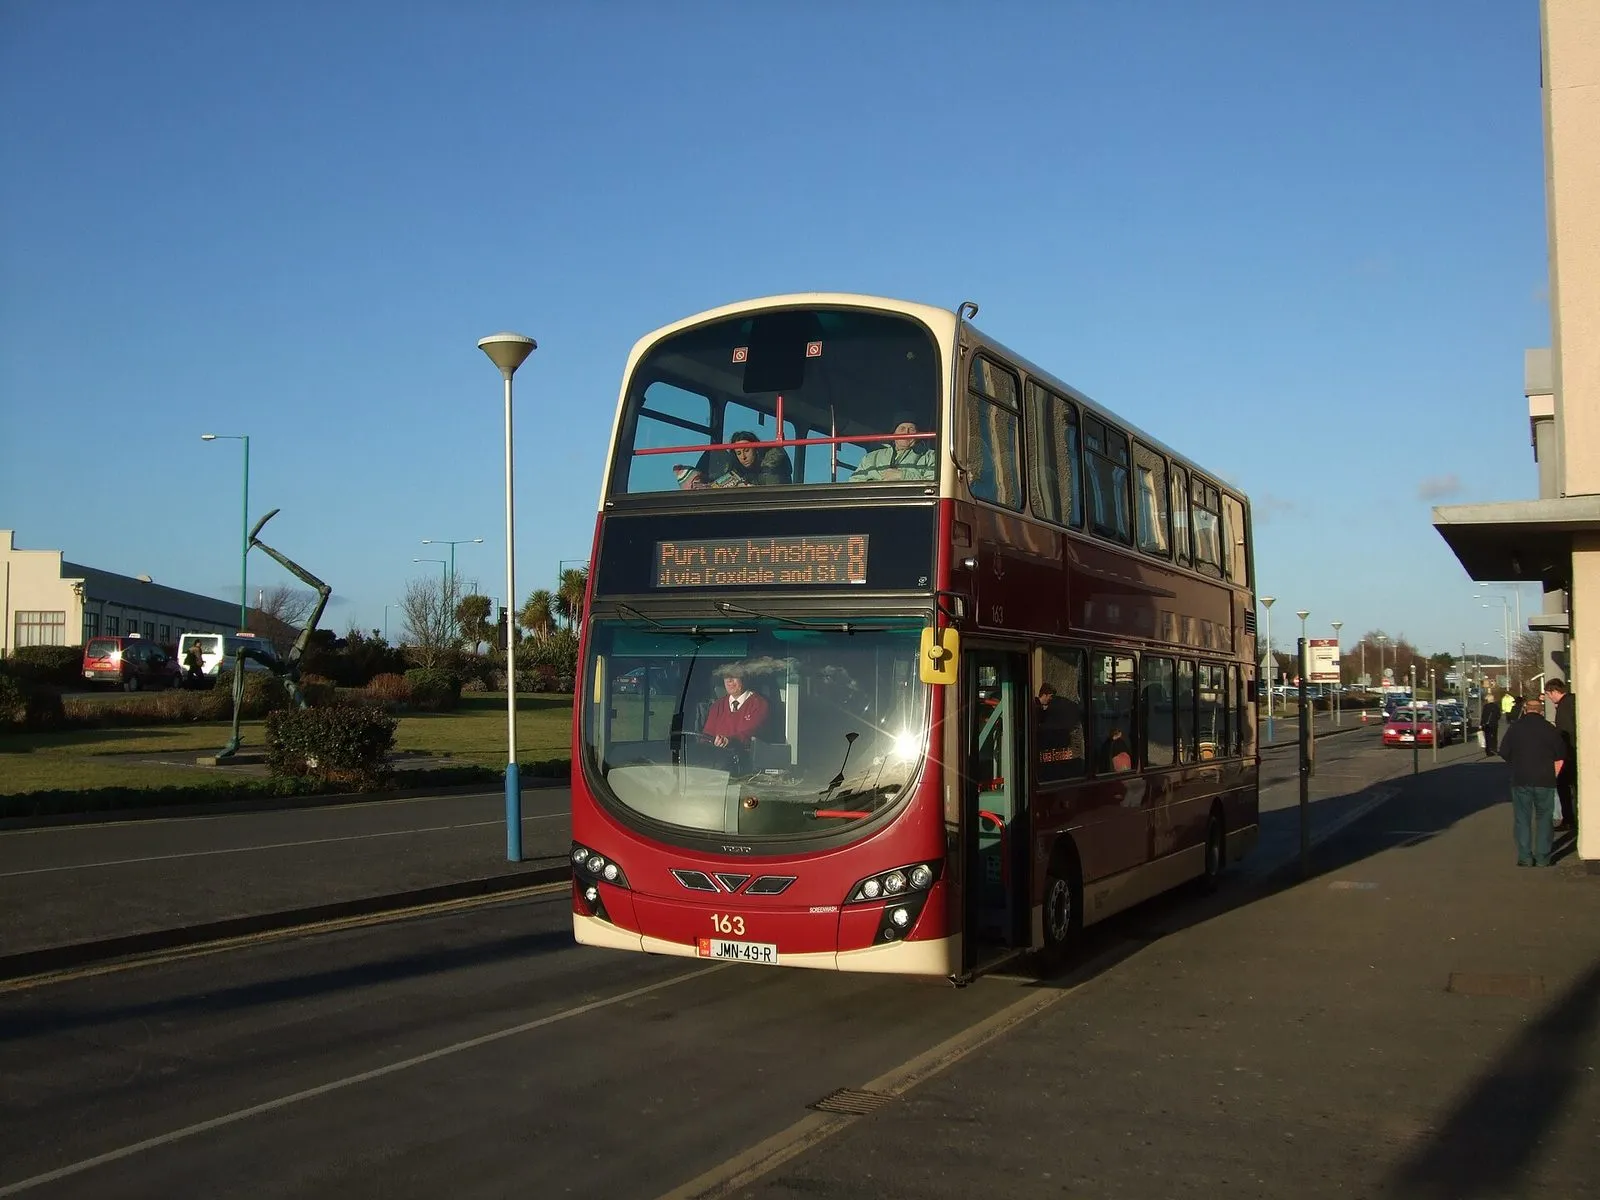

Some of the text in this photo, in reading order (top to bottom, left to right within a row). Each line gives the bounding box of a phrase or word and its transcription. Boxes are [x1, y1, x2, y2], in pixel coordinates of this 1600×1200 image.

[661, 543, 707, 566] Purt
[714, 547, 740, 564] ny
[847, 536, 865, 581] 8
[674, 568, 701, 585] via
[704, 566, 775, 584] Foxdale
[779, 565, 813, 582] and
[817, 564, 837, 582] St
[991, 604, 1004, 624] 163
[710, 913, 746, 936] 163
[716, 942, 771, 962] JMN-49-R
